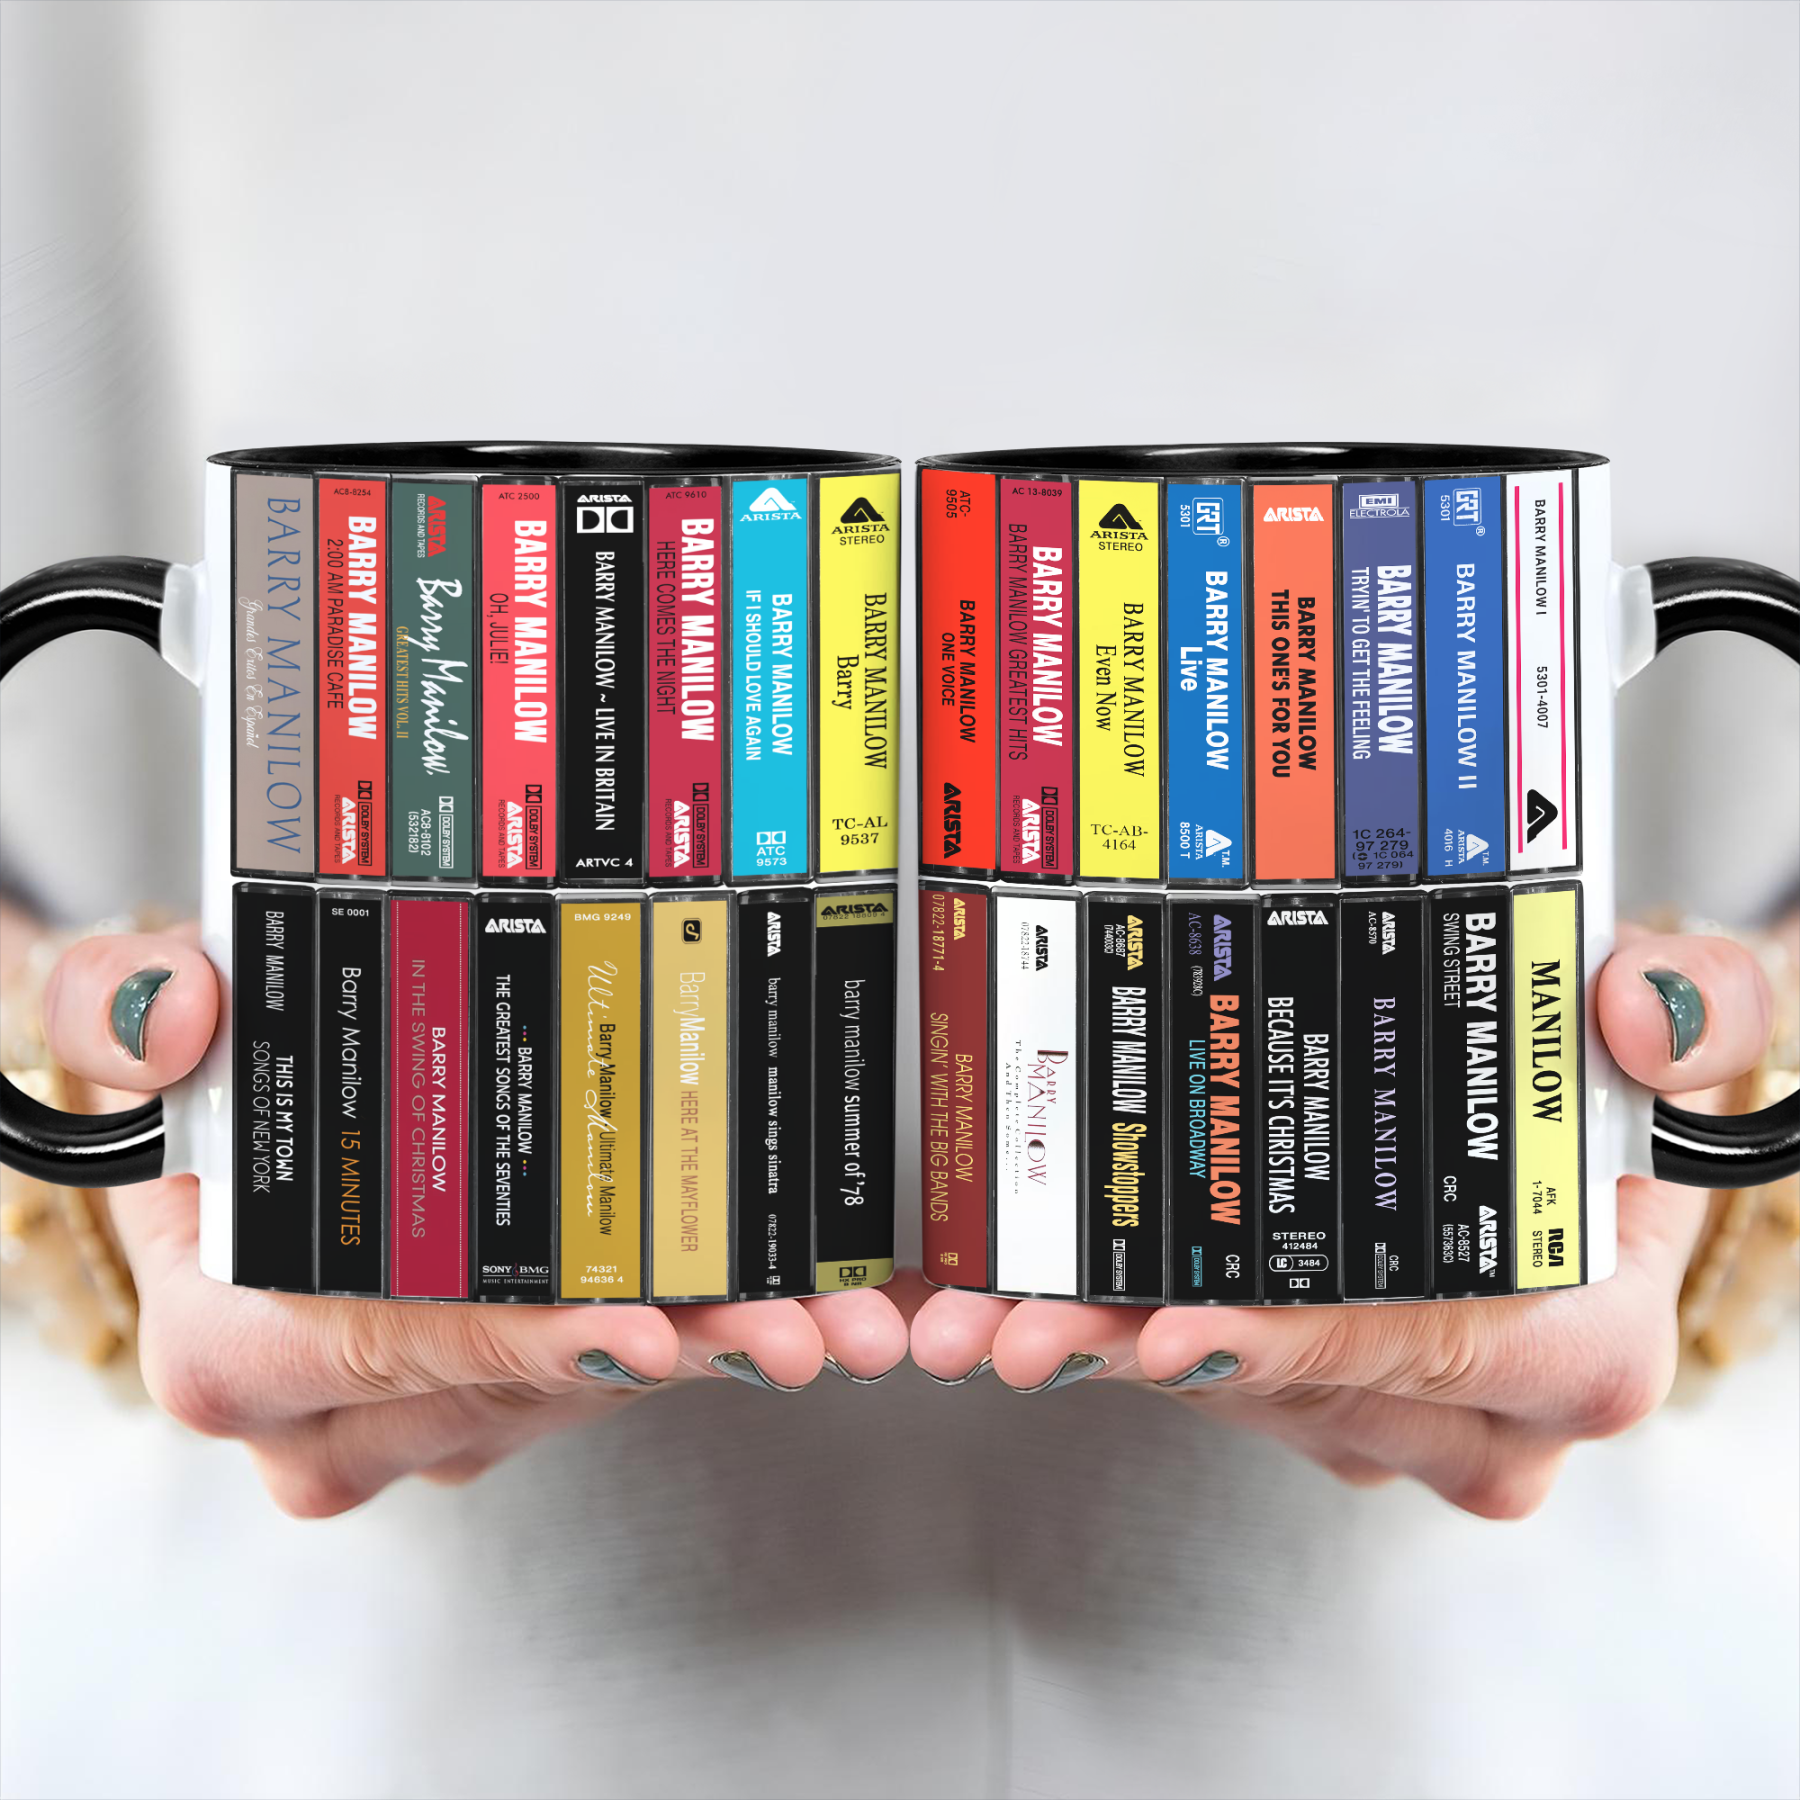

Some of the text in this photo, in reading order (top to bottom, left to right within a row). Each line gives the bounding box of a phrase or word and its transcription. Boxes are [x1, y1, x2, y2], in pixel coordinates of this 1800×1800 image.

[428, 496, 446, 557] ARISTA
[946, 489, 957, 518] 9505
[1090, 529, 1148, 540] ARISTA
[1181, 505, 1190, 527] 5301
[1263, 507, 1324, 522] ARISTA
[1535, 500, 1546, 541] BARRY
[839, 533, 884, 545] STEREO
[1099, 542, 1143, 551] STEREO
[1535, 546, 1546, 607] MANILOW
[327, 539, 344, 708] 2:00 AM PARADISE CAFE
[348, 516, 377, 739] BARRY MANILOW
[397, 626, 411, 673] GREATEST
[487, 593, 509, 663] OH, JULIE!
[514, 521, 547, 743] BARRY MANILOW
[657, 542, 676, 715] HERE COMES THE NIGHT
[681, 519, 714, 741] BARRY MANILOW
[1032, 546, 1063, 746] BARRY MANILOW
[267, 498, 302, 853] BARRY MANILOW
[397, 673, 408, 699] HITS
[595, 552, 615, 830] BARRY MANILOW LIVE IN BRITAIN
[772, 594, 792, 755] BARRY MANILOW
[832, 655, 859, 709] Barry
[865, 593, 887, 769] BARRY MANILOW
[942, 633, 955, 706] ONE VOICE
[960, 600, 976, 743] BARRY MANILOW
[1096, 644, 1116, 731] Even Now
[1181, 647, 1202, 691] Live
[1206, 571, 1229, 770] BARRY MANILOW
[1272, 589, 1290, 777] THIS ONE'S FOR YOU
[1352, 567, 1371, 759] TRYIN' TO GET THE FEELING
[1457, 564, 1477, 789] BARRY MANILOW II
[397, 699, 408, 728] VOL.
[1537, 667, 1548, 728] 5301-4007
[409, 811, 419, 853] (532182)
[757, 844, 785, 856] ATC
[832, 816, 888, 829] TC-AL
[841, 833, 879, 845] 9537
[1103, 839, 1136, 850] 4164
[576, 858, 633, 867] ARTVC 4
[757, 855, 787, 866] 9573
[485, 918, 546, 933] ARISTA
[575, 913, 631, 921] BMG 9249
[767, 912, 781, 957] ARISTA
[933, 894, 944, 970] 07822-18771-4
[1036, 925, 1048, 971] ARISTA
[1116, 924, 1125, 957] AC-8687
[266, 911, 284, 1011] BARRY MANILOW
[1443, 913, 1460, 1008] SWING STREET
[840, 980, 865, 1019] barry
[338, 967, 362, 1118] Barry Manilow
[845, 1025, 865, 1090] manilow
[1532, 959, 1562, 1122] MANILOW
[412, 960, 425, 1237] IN THE SWING OF CHRISTMAS
[432, 1027, 446, 1192] BARRY MANILOW
[496, 974, 510, 1226] THE GREATEST SONGS OF THE SEVENTIES
[765, 978, 781, 1194] barry manilow manilow sings sinatra
[1104, 987, 1147, 1228] BARRY MANILOW Showstoppers
[1189, 1040, 1206, 1178] LIVE ON BROADWAY
[1210, 995, 1241, 1225] BARRY MANILOW
[1268, 997, 1295, 1213] BECAUSE IT'S CHRISTMAS
[1374, 997, 1397, 1211] BARRY MANILOW
[276, 1056, 293, 1181] THIS IS MY TOWN
[844, 1096, 860, 1157] summer
[955, 1054, 973, 1182] BARRY MANILOW
[341, 1131, 360, 1245] 15 MINUTES
[681, 1091, 698, 1251] HERE AT THE MAYFLOWER
[1547, 1187, 1556, 1205] AFK
[768, 1214, 777, 1269] 07822-19033-4
[1226, 1255, 1240, 1278] CRC
[1273, 1232, 1326, 1240] STEREO
[1389, 1255, 1399, 1271] CRC
[1458, 1224, 1470, 1262] AC-8527
[1533, 1231, 1543, 1267] STEREO
[1548, 1228, 1563, 1267] RCA
